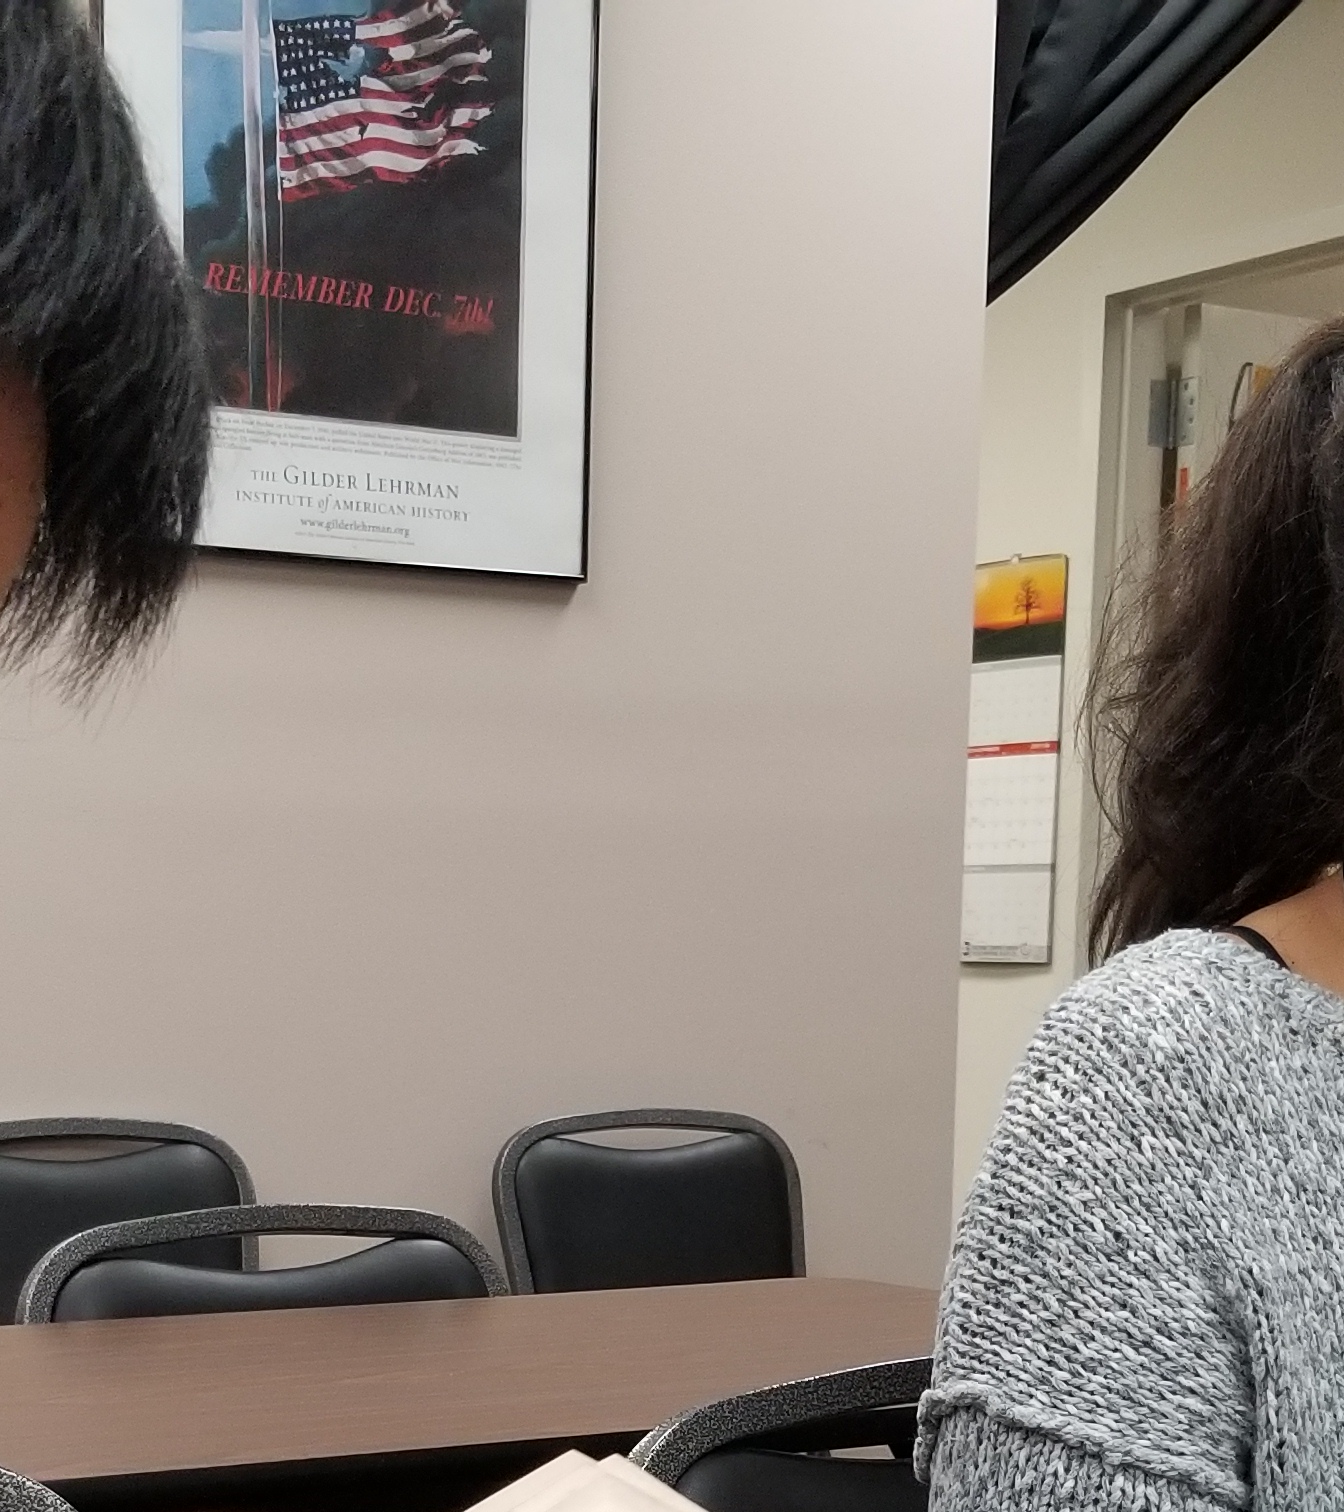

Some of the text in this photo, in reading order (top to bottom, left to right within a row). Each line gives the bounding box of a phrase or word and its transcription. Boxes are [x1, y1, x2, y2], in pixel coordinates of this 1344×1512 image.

[205, 262, 374, 308] REMEMBER
[250, 464, 460, 500] THE GILDER LEHRMAN
[236, 489, 472, 522] INSTITUTE of AMERICAN HISTORY
[300, 517, 411, 538] www.gilderlehrman.org
